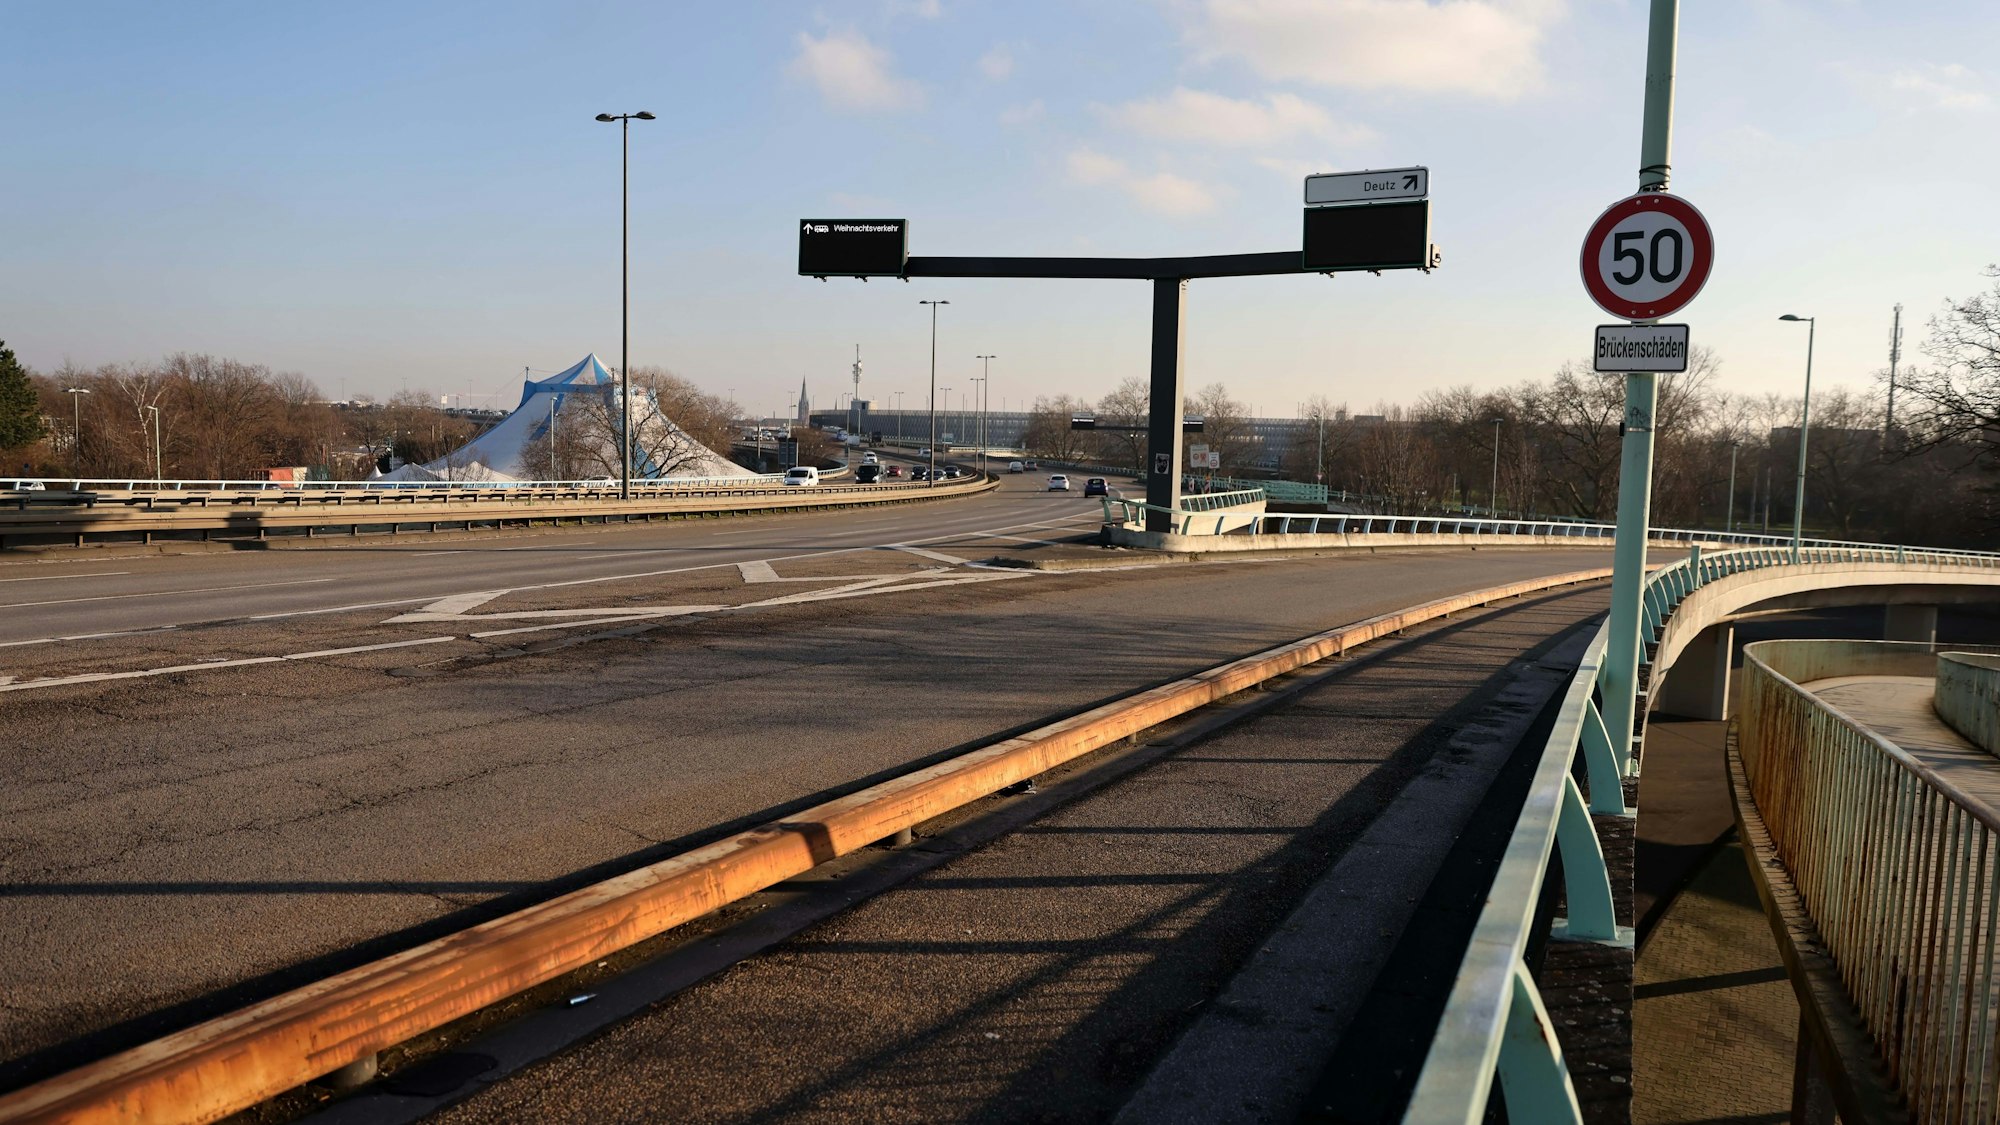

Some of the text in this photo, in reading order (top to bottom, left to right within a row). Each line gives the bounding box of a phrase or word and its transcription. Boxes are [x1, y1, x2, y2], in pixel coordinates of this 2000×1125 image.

[1364, 181, 1396, 192] Deutz
[833, 224, 899, 233] Weihnachtsverkehr
[1612, 228, 1683, 286] 50
[1598, 336, 1684, 359] Brückenschäden
